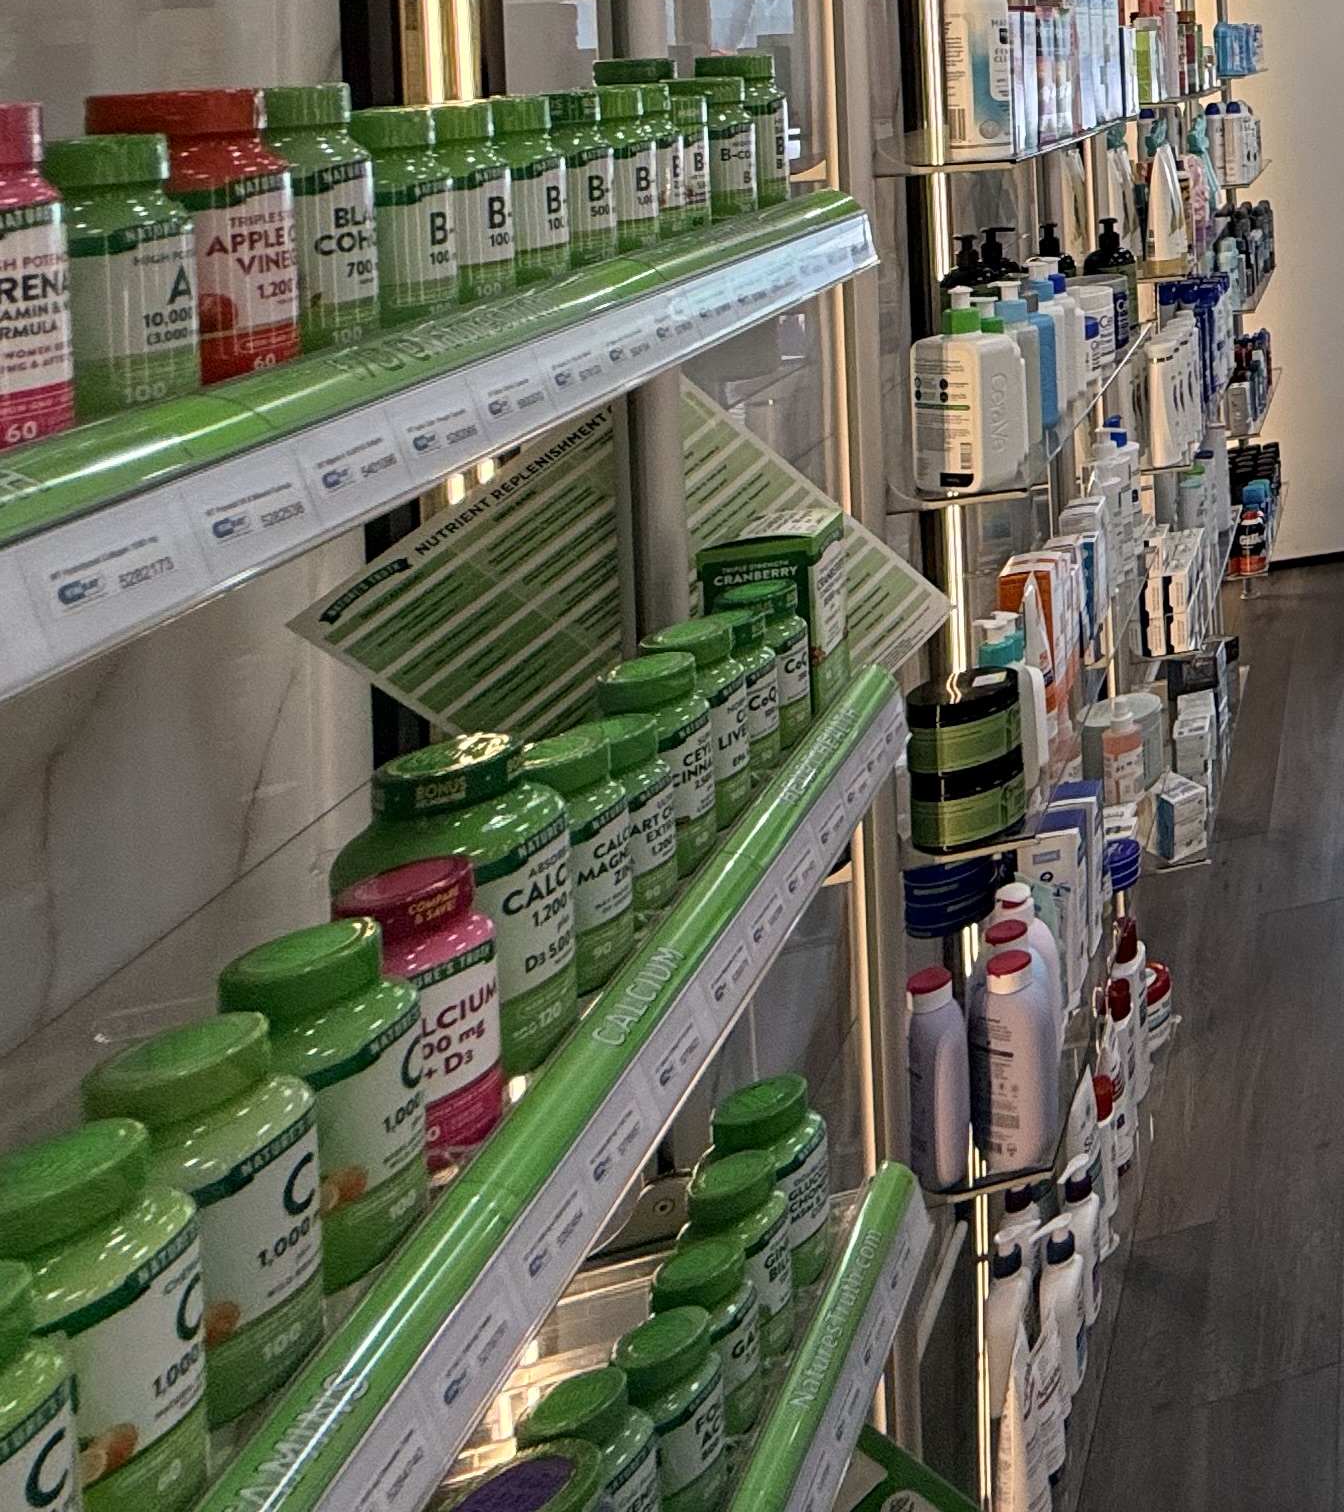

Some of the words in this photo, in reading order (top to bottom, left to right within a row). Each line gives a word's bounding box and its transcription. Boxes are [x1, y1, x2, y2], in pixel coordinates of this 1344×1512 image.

[206, 227, 285, 259] APPLE
[167, 266, 191, 306] A
[6, 420, 38, 440] 60
[413, 496, 489, 558] NUTRIENT
[489, 416, 608, 510] REPLENISHMENT
[713, 565, 798, 587] CRANBERRY
[591, 947, 684, 1046] CALCIUM
[459, 1021, 485, 1042] mg
[283, 1151, 315, 1216] C
[257, 1218, 310, 1269] 1,000
[788, 1228, 883, 1410] NaturesTruth.com
[25, 1426, 68, 1507] C
